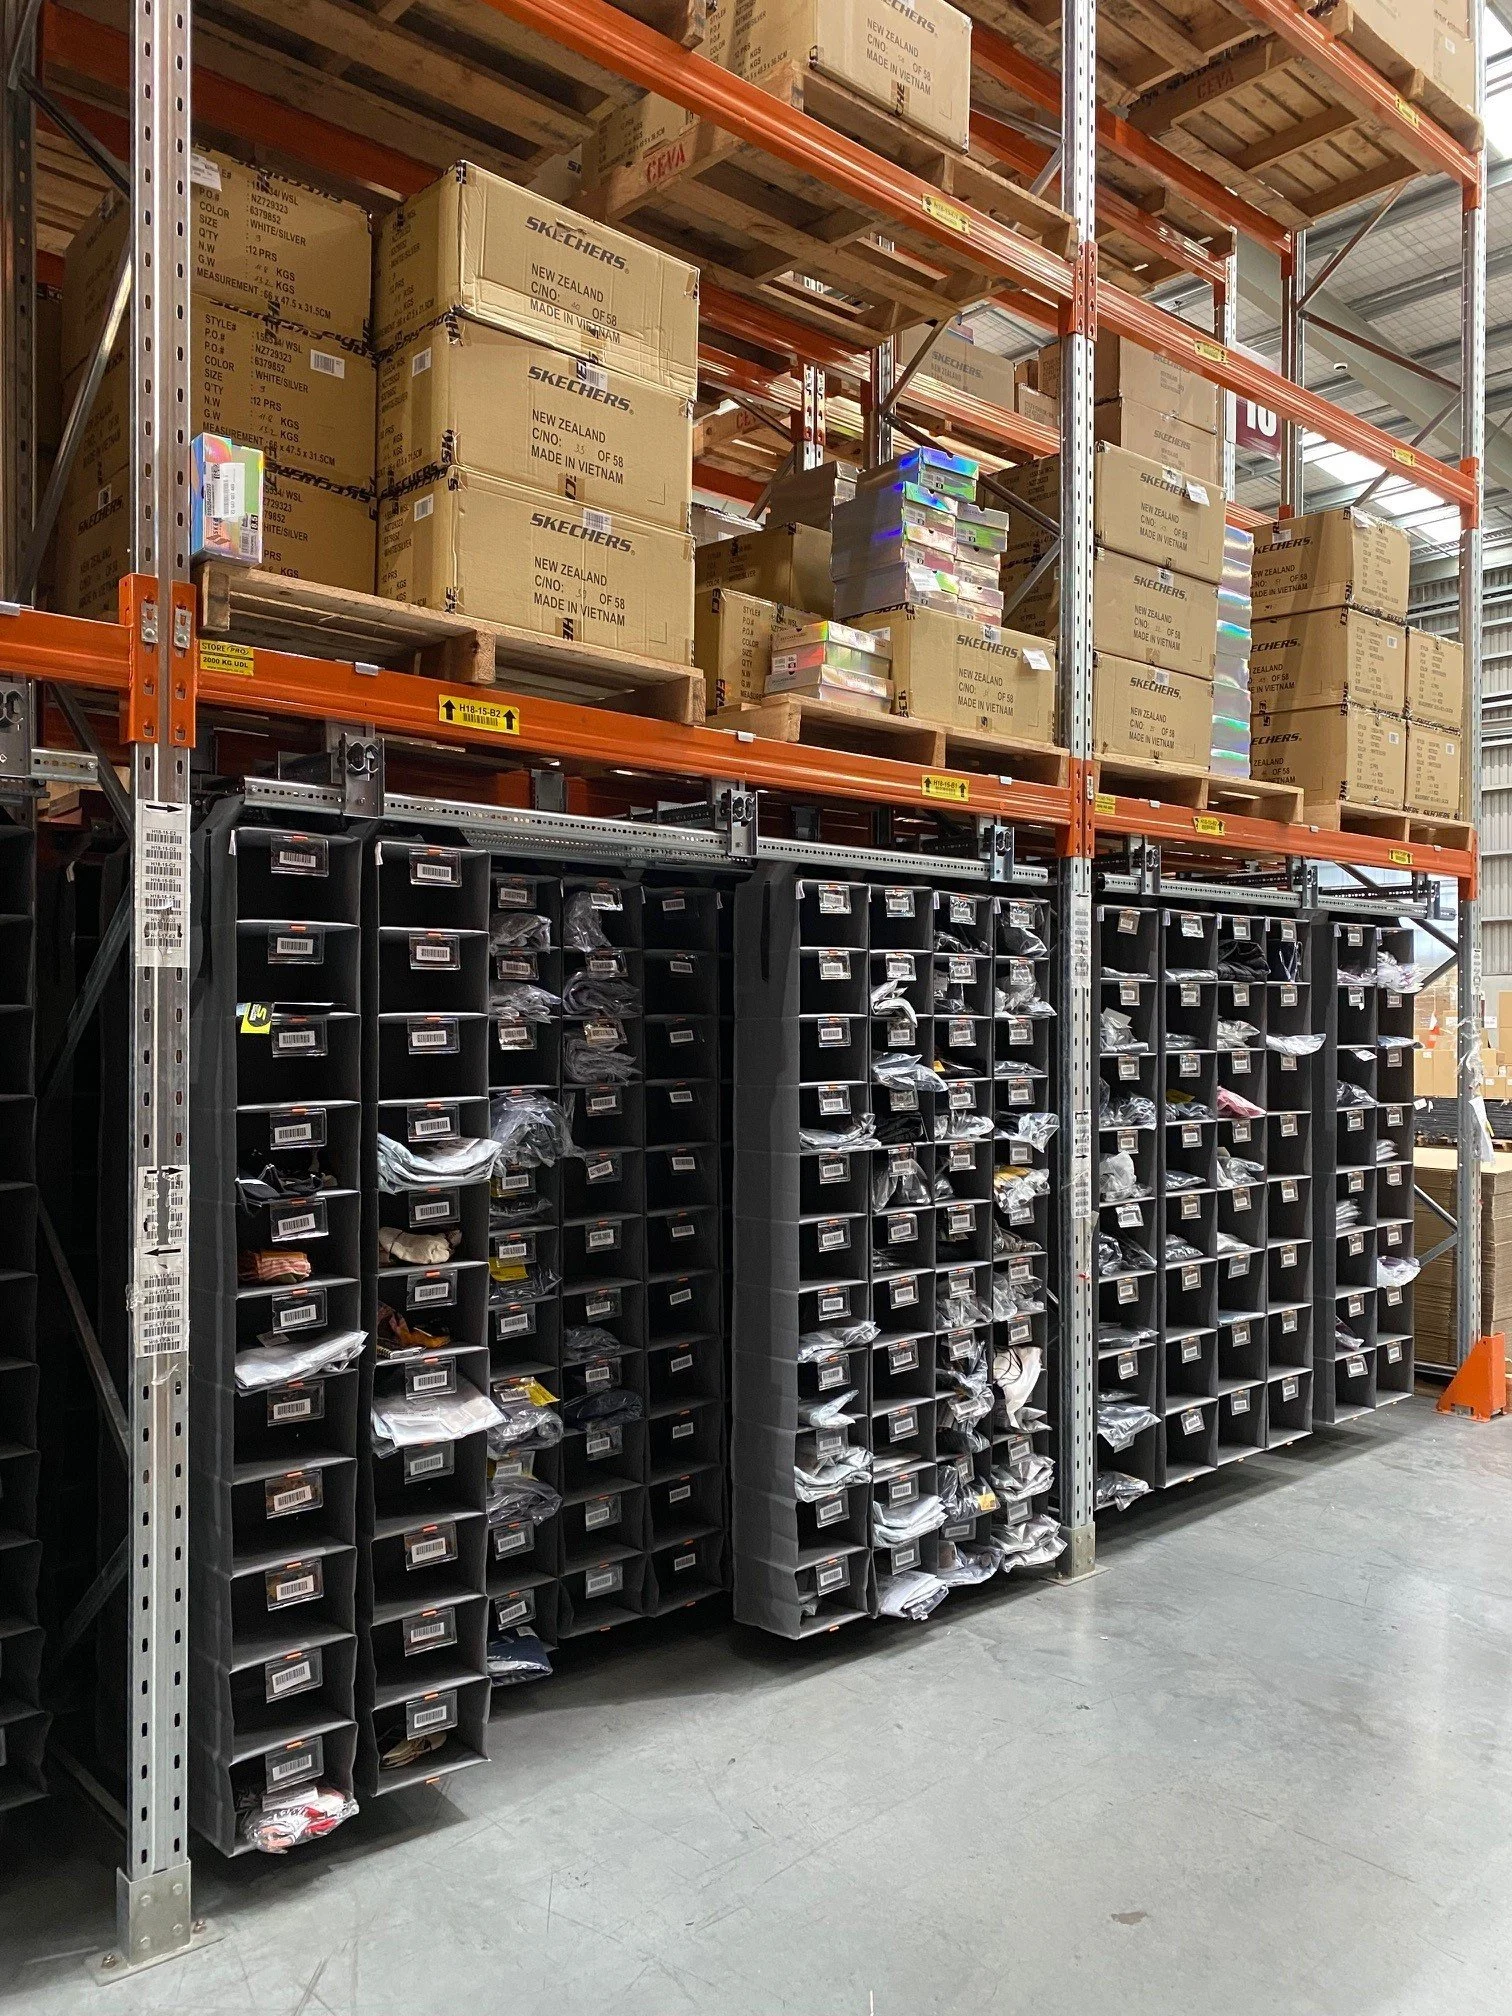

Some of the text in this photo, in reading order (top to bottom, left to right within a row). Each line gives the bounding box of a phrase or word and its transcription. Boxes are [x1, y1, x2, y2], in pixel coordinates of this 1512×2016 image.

[867, 18, 918, 57] NEW ZEALAND
[866, 49, 931, 95] MADE IN VIETNAM
[912, 63, 922, 74] OF
[646, 142, 685, 183] CEVA
[251, 194, 289, 214] NZ729323
[282, 192, 298, 206] WSL
[199, 214, 218, 228] SIZE
[199, 201, 306, 246] COLOR WHITE/SILVER
[249, 205, 281, 225] 6379852
[525, 216, 628, 271] SKECHERS
[198, 241, 295, 281] N.W KGS
[259, 248, 277, 262] PRS
[198, 255, 295, 294] G.W KGS
[531, 263, 604, 303] NEW ZEALAND
[196, 267, 258, 295] MEASUREMENT
[304, 303, 331, 320] 31.5CM
[531, 281, 617, 326] C/NO: OF 58
[530, 299, 621, 344] MADE IN VIETNAM
[205, 314, 302, 353] STYLE# WSL
[205, 328, 292, 363] P.O.# NZ729323
[204, 342, 286, 373] P.O.# 6379852
[932, 351, 983, 379] SKECHERS
[204, 355, 308, 393] COLOR WHITE/SILVER
[204, 369, 222, 381] SIZE
[204, 382, 282, 412] Q'TY PRS
[527, 365, 631, 411] SKECHERS
[204, 395, 299, 430] N.W KGS
[204, 408, 299, 443] G.W KGS
[532, 409, 606, 443] NEW ZEALAND
[203, 422, 335, 466] MEASUREMENT 47.5 31.5CM
[532, 428, 624, 468] C/NO: OF 58
[1154, 429, 1191, 451] SKECHERS
[531, 445, 623, 485] MADE IN VIETNAM
[286, 490, 303, 502] WSL
[1140, 502, 1179, 524] NEW ZEALAND
[263, 525, 308, 541] HITE/SILVER
[530, 512, 633, 553] SKECHERS
[1140, 526, 1187, 551] MADE IN VIETNAM
[1174, 526, 1180, 536] OF
[264, 550, 282, 561] PRS
[1253, 536, 1311, 555] KECHERS
[280, 567, 299, 578] KGS
[534, 556, 607, 587] NEW ZEALAND
[1264, 565, 1295, 576] ZEALAND
[1290, 575, 1299, 583] OF
[534, 575, 625, 610] C/NO: OF 58
[1133, 575, 1186, 600] SKECHERS
[1269, 583, 1308, 595] IN VIETNAM
[534, 593, 625, 627] MADE IN VIETNAM
[1134, 605, 1172, 623] NEW ZEALAND
[742, 638, 759, 648] COLOR
[1133, 629, 1180, 651] MADE IN VIETNAM
[1167, 628, 1174, 638] OF
[202, 643, 225, 652] STORE
[741, 649, 753, 657] SIZE
[956, 634, 1018, 658] SKECHERS
[1251, 638, 1299, 653] ECHERS
[958, 668, 1003, 686] NEW ZEALAND
[1252, 664, 1283, 674] ZEALAND
[998, 692, 1006, 701] OF
[1130, 677, 1181, 698] SKECHERS
[1257, 682, 1295, 693] IN VIETNAM
[459, 703, 501, 718] H18-15-B2
[958, 696, 1014, 716] MADE IN VIETNAM
[1130, 707, 1166, 723] NEW ZEALAND
[1129, 731, 1174, 749] MADE IN VIETNAM
[1161, 728, 1168, 736] OF
[1251, 732, 1300, 745] ECHERS
[1254, 757, 1284, 767] ZEALAND
